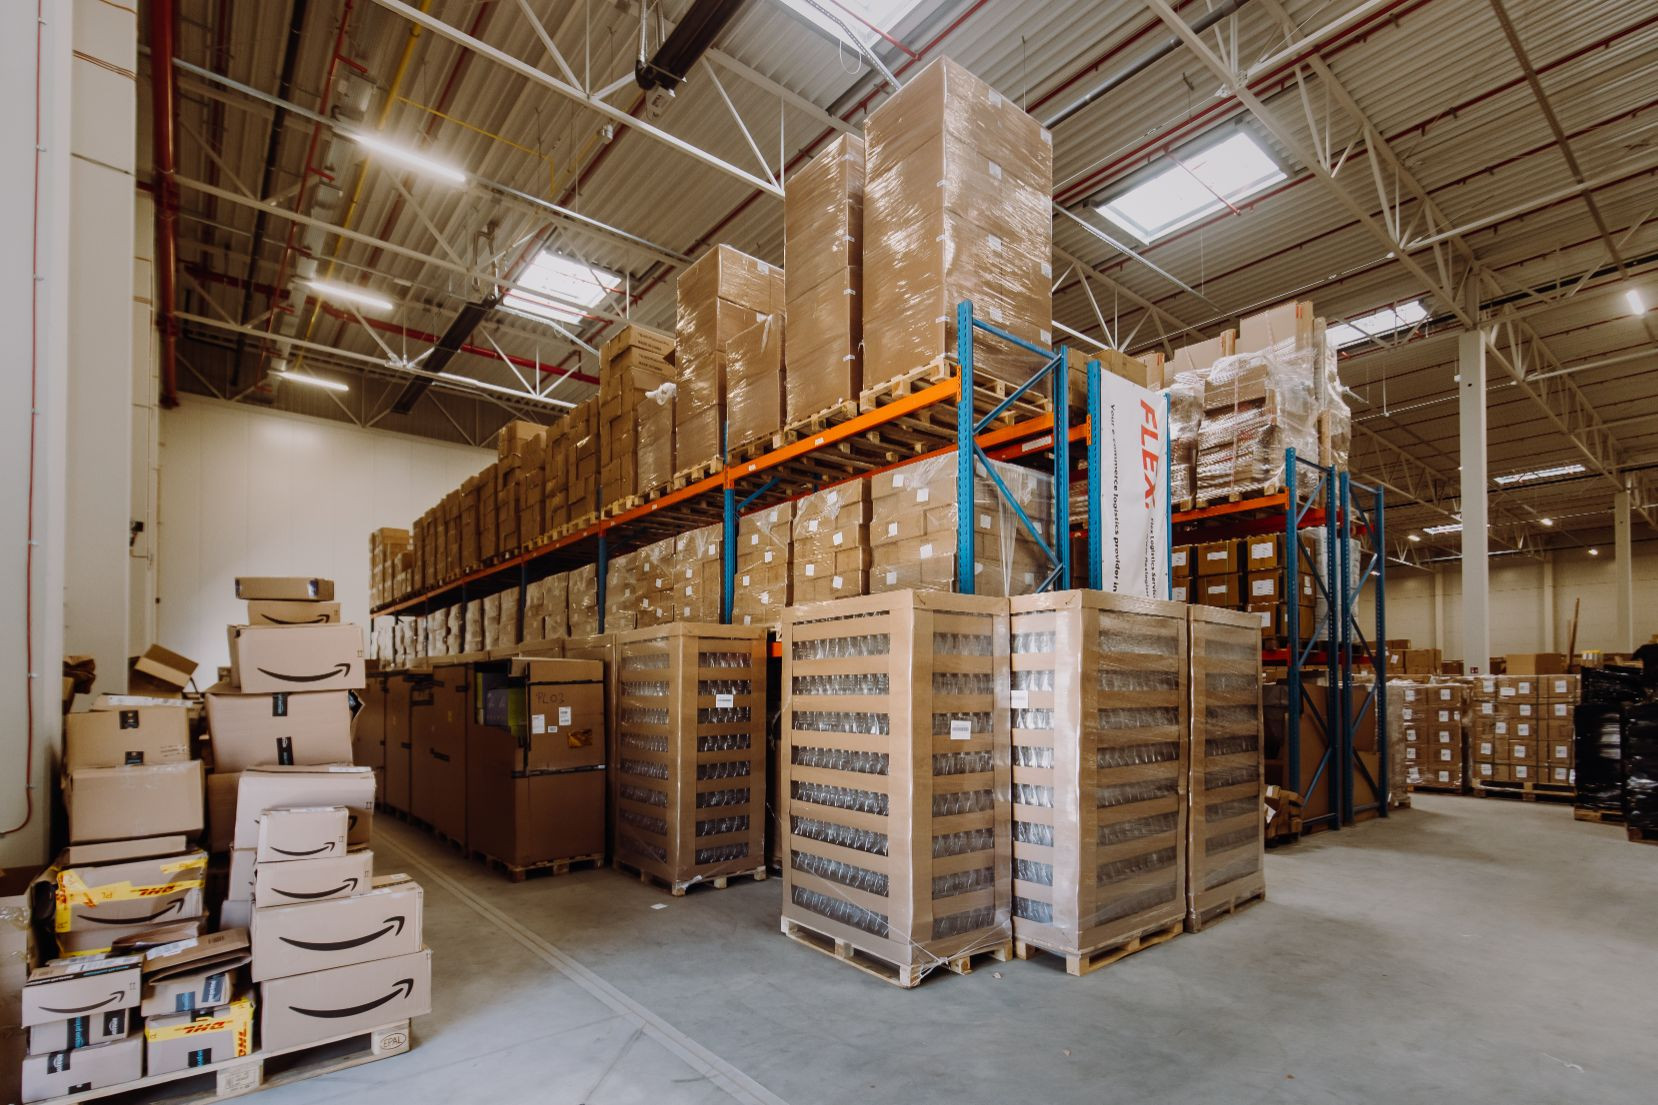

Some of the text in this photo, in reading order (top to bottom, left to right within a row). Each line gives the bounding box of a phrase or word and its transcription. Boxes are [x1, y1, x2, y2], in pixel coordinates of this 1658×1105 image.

[1112, 493, 1120, 536] logistics
[1113, 536, 1121, 579] provider
[1112, 581, 1120, 594] in
[138, 885, 176, 897] DHL
[183, 1021, 225, 1034] DHL
[238, 1028, 247, 1057] DHL
[383, 1036, 403, 1048] EPAL
